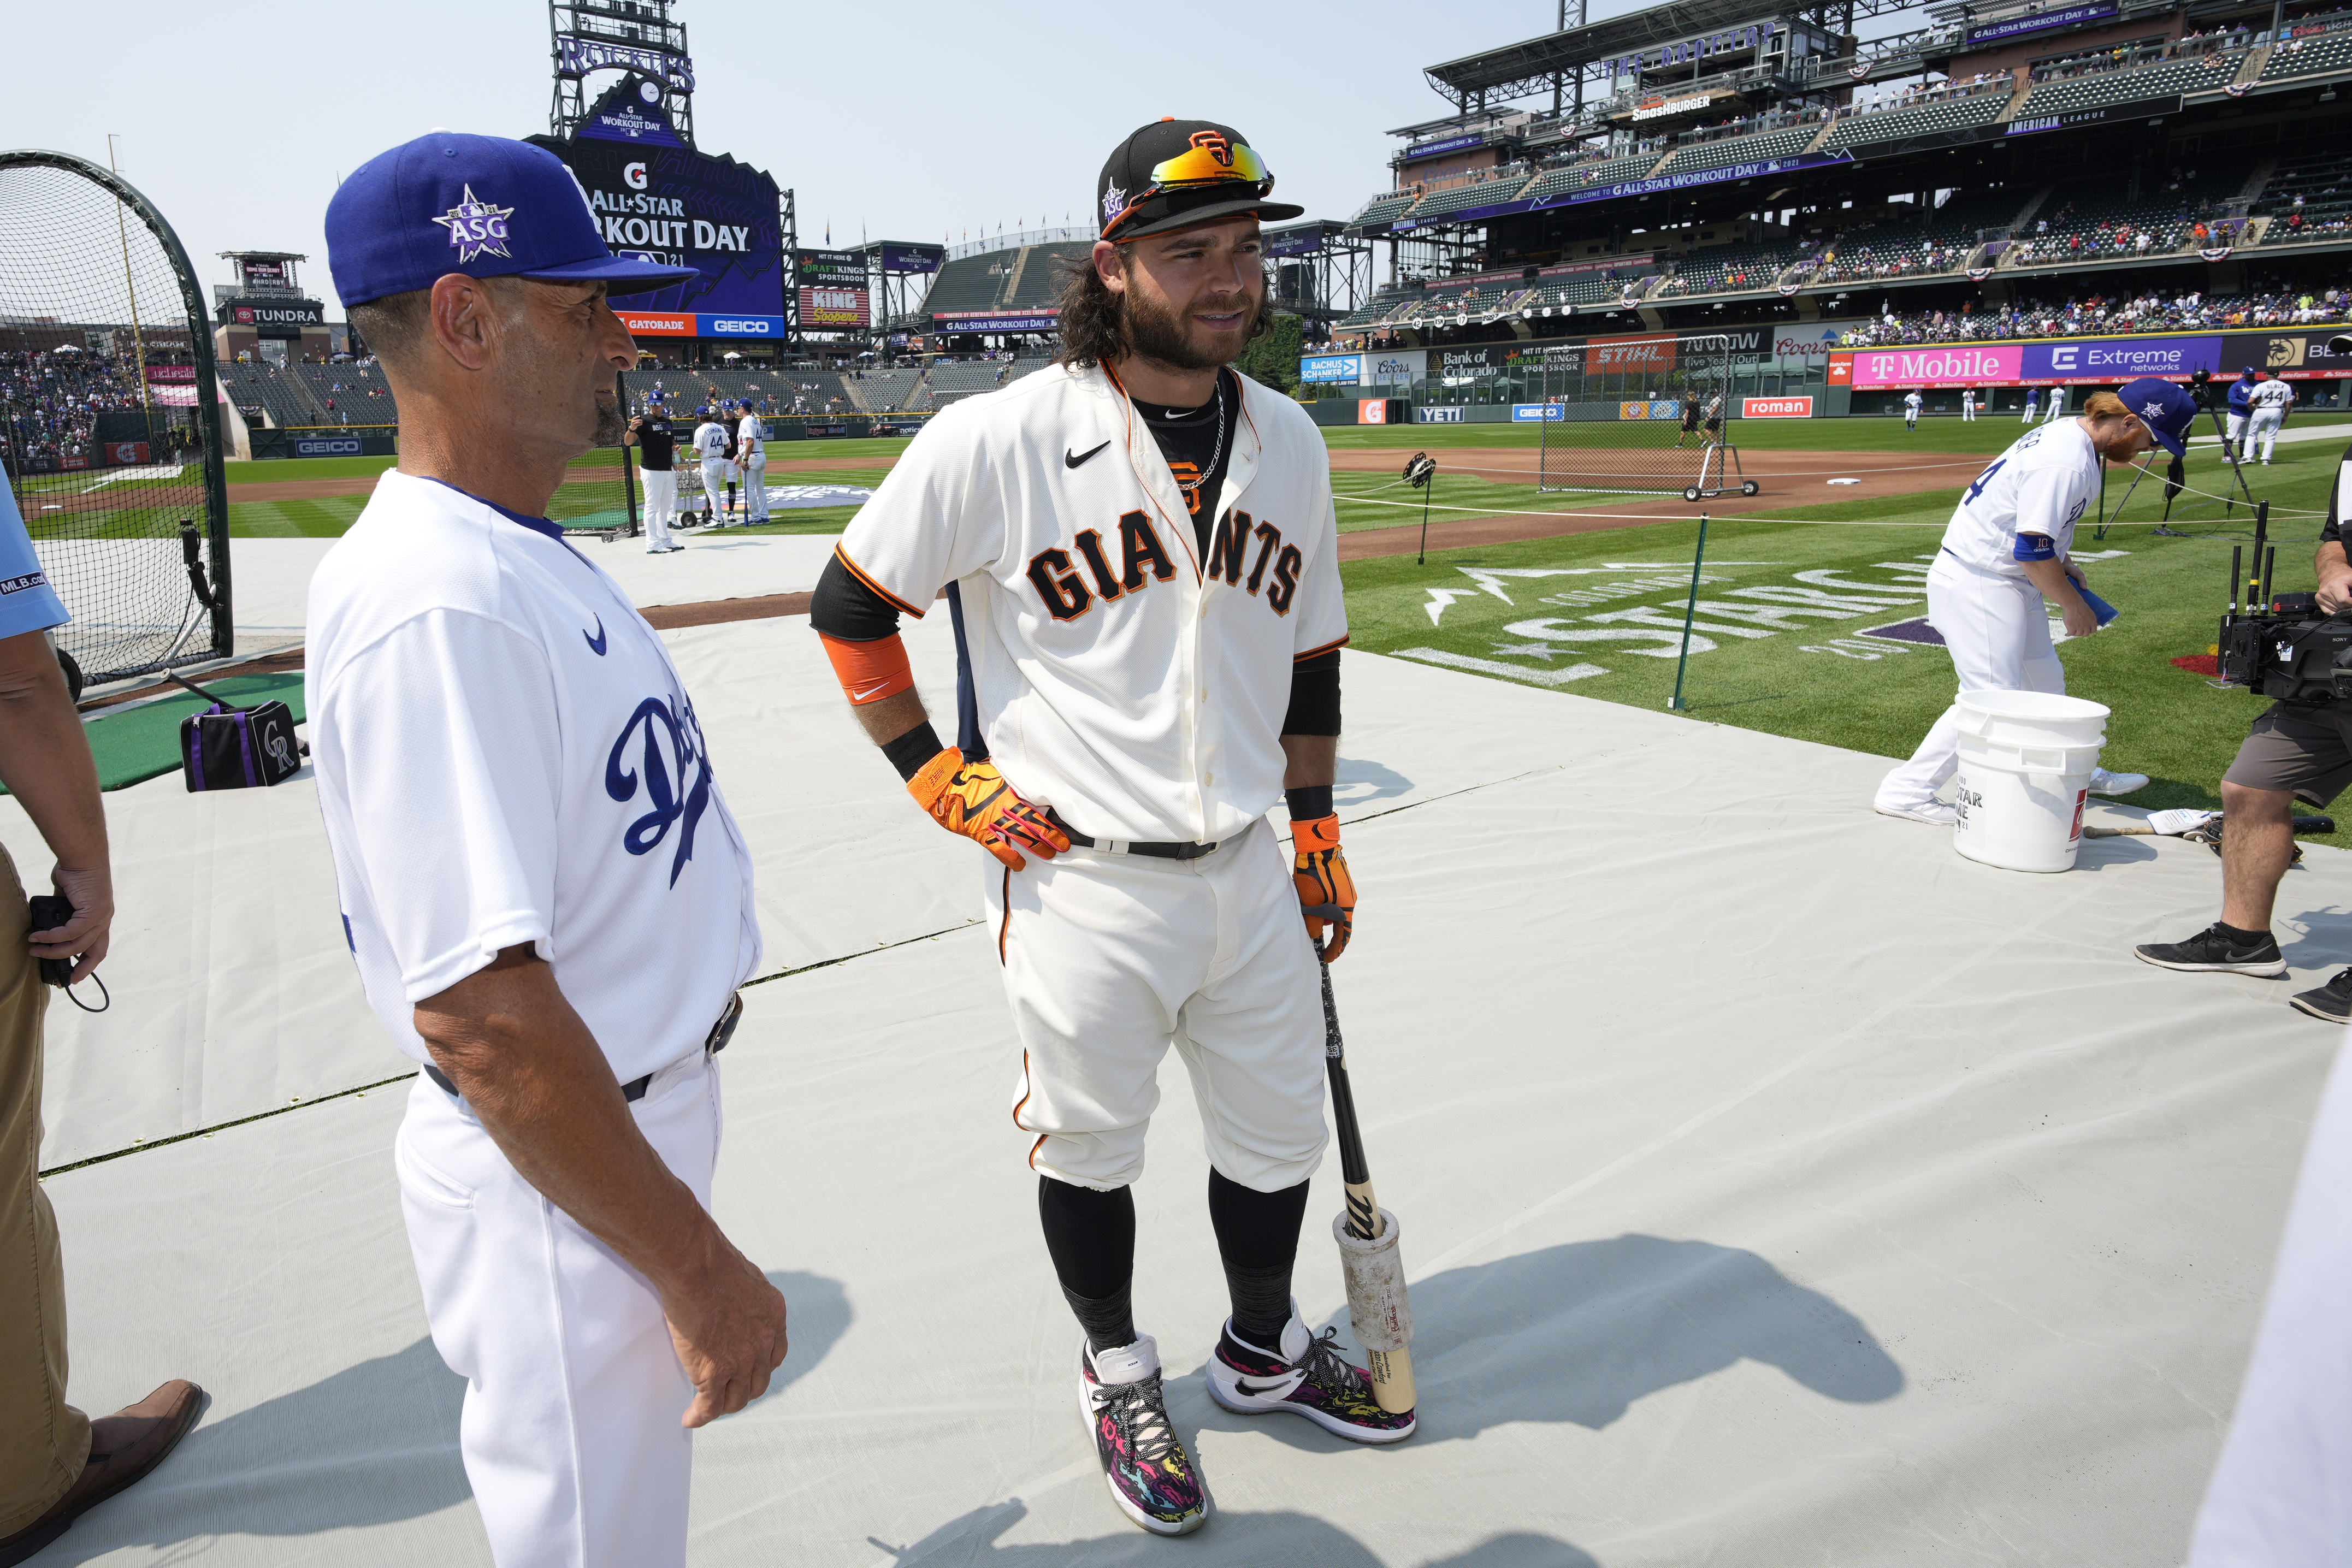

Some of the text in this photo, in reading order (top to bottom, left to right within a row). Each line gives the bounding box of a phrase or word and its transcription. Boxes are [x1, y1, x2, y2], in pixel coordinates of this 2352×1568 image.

[2019, 14, 2063, 29] WORKOUT
[2065, 10, 2083, 20] DAY
[2292, 25, 2325, 37] Coors
[1603, 22, 1775, 80] THE ROOFTOP
[557, 37, 695, 91] ROCKIES
[601, 116, 661, 131] WORKOUT DAY
[2007, 111, 2105, 134] AMERICAN LEAGUE
[1433, 141, 1456, 150] WORKOUT
[1571, 191, 1600, 200] WELCOME
[1673, 168, 1733, 186] WORKOUT
[1735, 163, 1759, 177] DAY
[1783, 159, 1799, 168] 2021
[1105, 197, 1122, 217] ASG
[452, 217, 507, 244] ASG
[1393, 218, 1416, 230] NATIONAL
[693, 220, 749, 251] DAY
[1272, 240, 1294, 249] WORKOUT
[671, 254, 684, 267] 21
[803, 264, 865, 275] DRAFTKINGS
[818, 274, 865, 282] SPORTSBOOK
[812, 292, 856, 309] KING
[253, 309, 317, 322] TUNDRA
[813, 307, 858, 325] Soopers
[629, 321, 684, 330] GATORADE
[714, 320, 769, 333] GEICO
[988, 320, 1029, 329] WORKOUT
[1030, 319, 1045, 327] DAY
[1776, 338, 1831, 356] Coors
[1444, 348, 1487, 365] Bank of
[1506, 354, 1579, 366] DRAFTKINGS
[1597, 346, 1664, 364] STIHL
[1737, 355, 1757, 364] Out
[2088, 350, 2179, 364] Extreme
[1311, 359, 1342, 370] BACHUS
[1378, 360, 1409, 374] Coors
[1443, 363, 1497, 378] Colorado
[1522, 364, 1578, 373] SPORSBOOK
[1899, 351, 1999, 379] Mobile
[2130, 363, 2179, 371] networks
[1302, 369, 1342, 379] SCHANKER
[2265, 391, 2284, 401] 44
[1520, 409, 1557, 417] GEICO
[1751, 401, 1804, 413] roman
[2144, 405, 2160, 417] ASG
[1423, 409, 1463, 421] YETI
[705, 426, 723, 436] LEHMANN
[756, 428, 763, 442] 44
[808, 426, 846, 436] Exxon Mobil
[299, 440, 359, 453] GEICO
[710, 435, 723, 450] 44
[2038, 538, 2048, 548] 10
[1026, 508, 1302, 622] GIANTS
[1962, 821, 1968, 830] 21
[1376, 1362, 1387, 1384] Crawford
